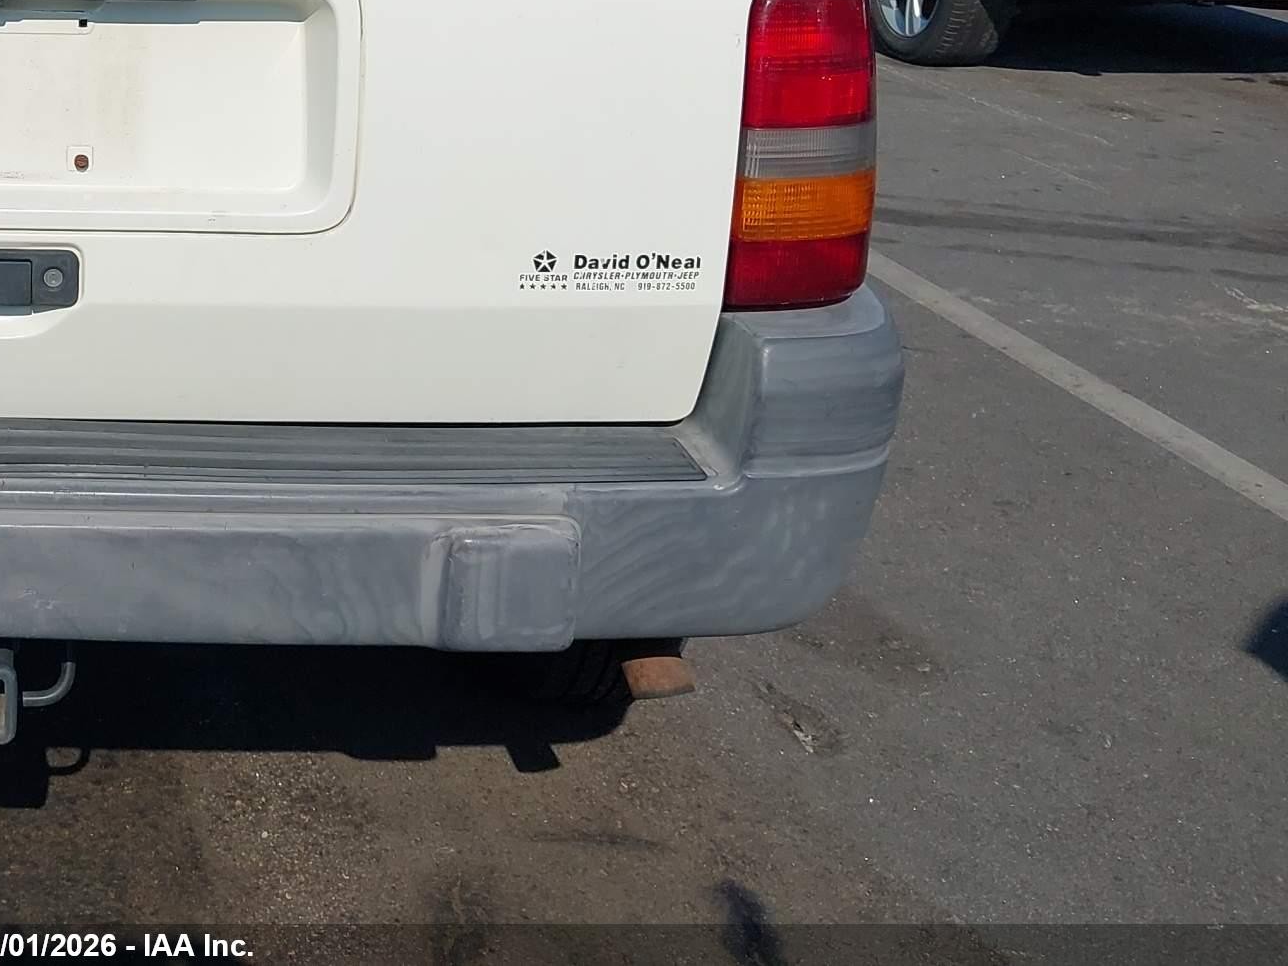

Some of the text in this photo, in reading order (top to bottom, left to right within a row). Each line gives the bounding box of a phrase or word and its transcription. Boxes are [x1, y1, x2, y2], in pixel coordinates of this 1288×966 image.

[574, 252, 702, 270] David O'Neal
[519, 274, 568, 282] FIVE STAR
[614, 282, 625, 291] NC
[638, 282, 696, 291] 919-872-5500
